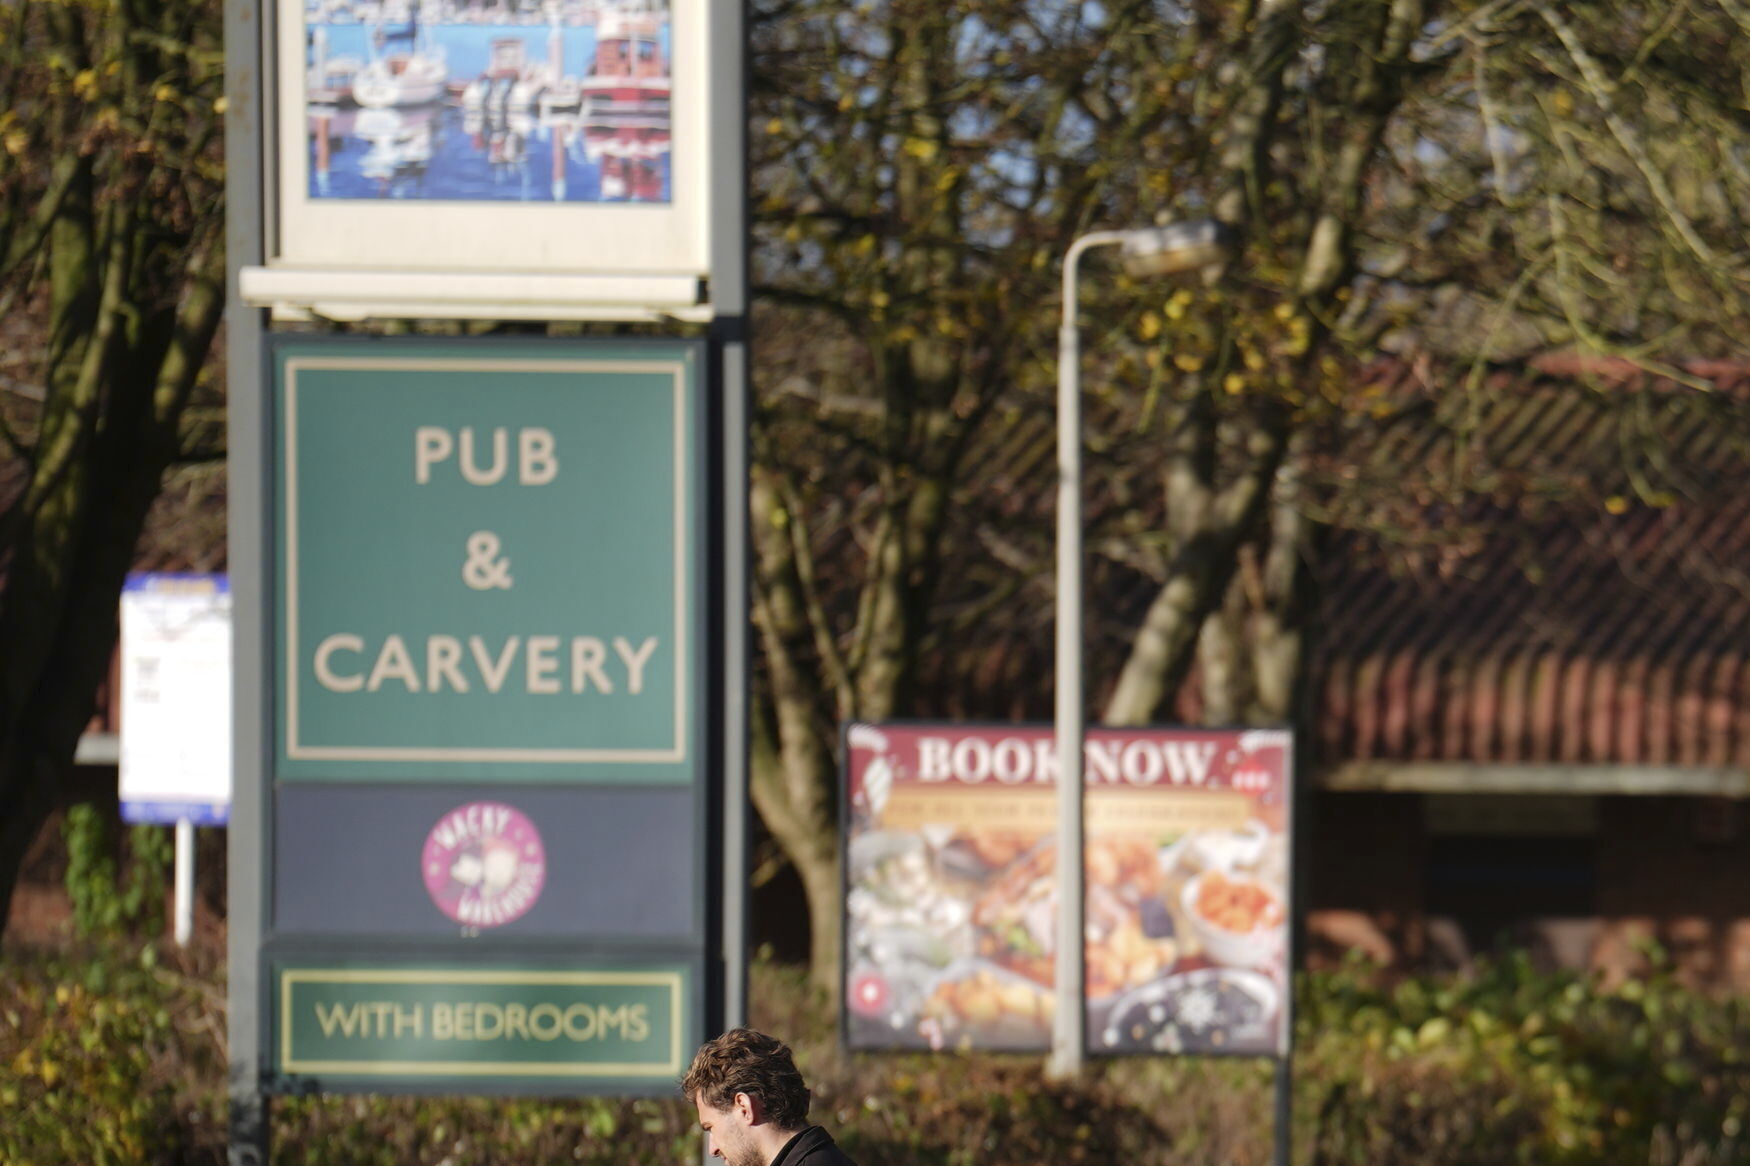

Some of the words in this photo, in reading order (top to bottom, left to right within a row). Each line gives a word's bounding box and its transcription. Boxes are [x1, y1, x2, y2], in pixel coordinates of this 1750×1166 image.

[415, 426, 560, 486] PUB
[462, 530, 514, 591] &
[313, 633, 659, 694] CARVERY
[1083, 739, 1218, 786] NOW
[314, 1002, 423, 1040] WITH
[431, 1002, 648, 1042] BEDROOMS
